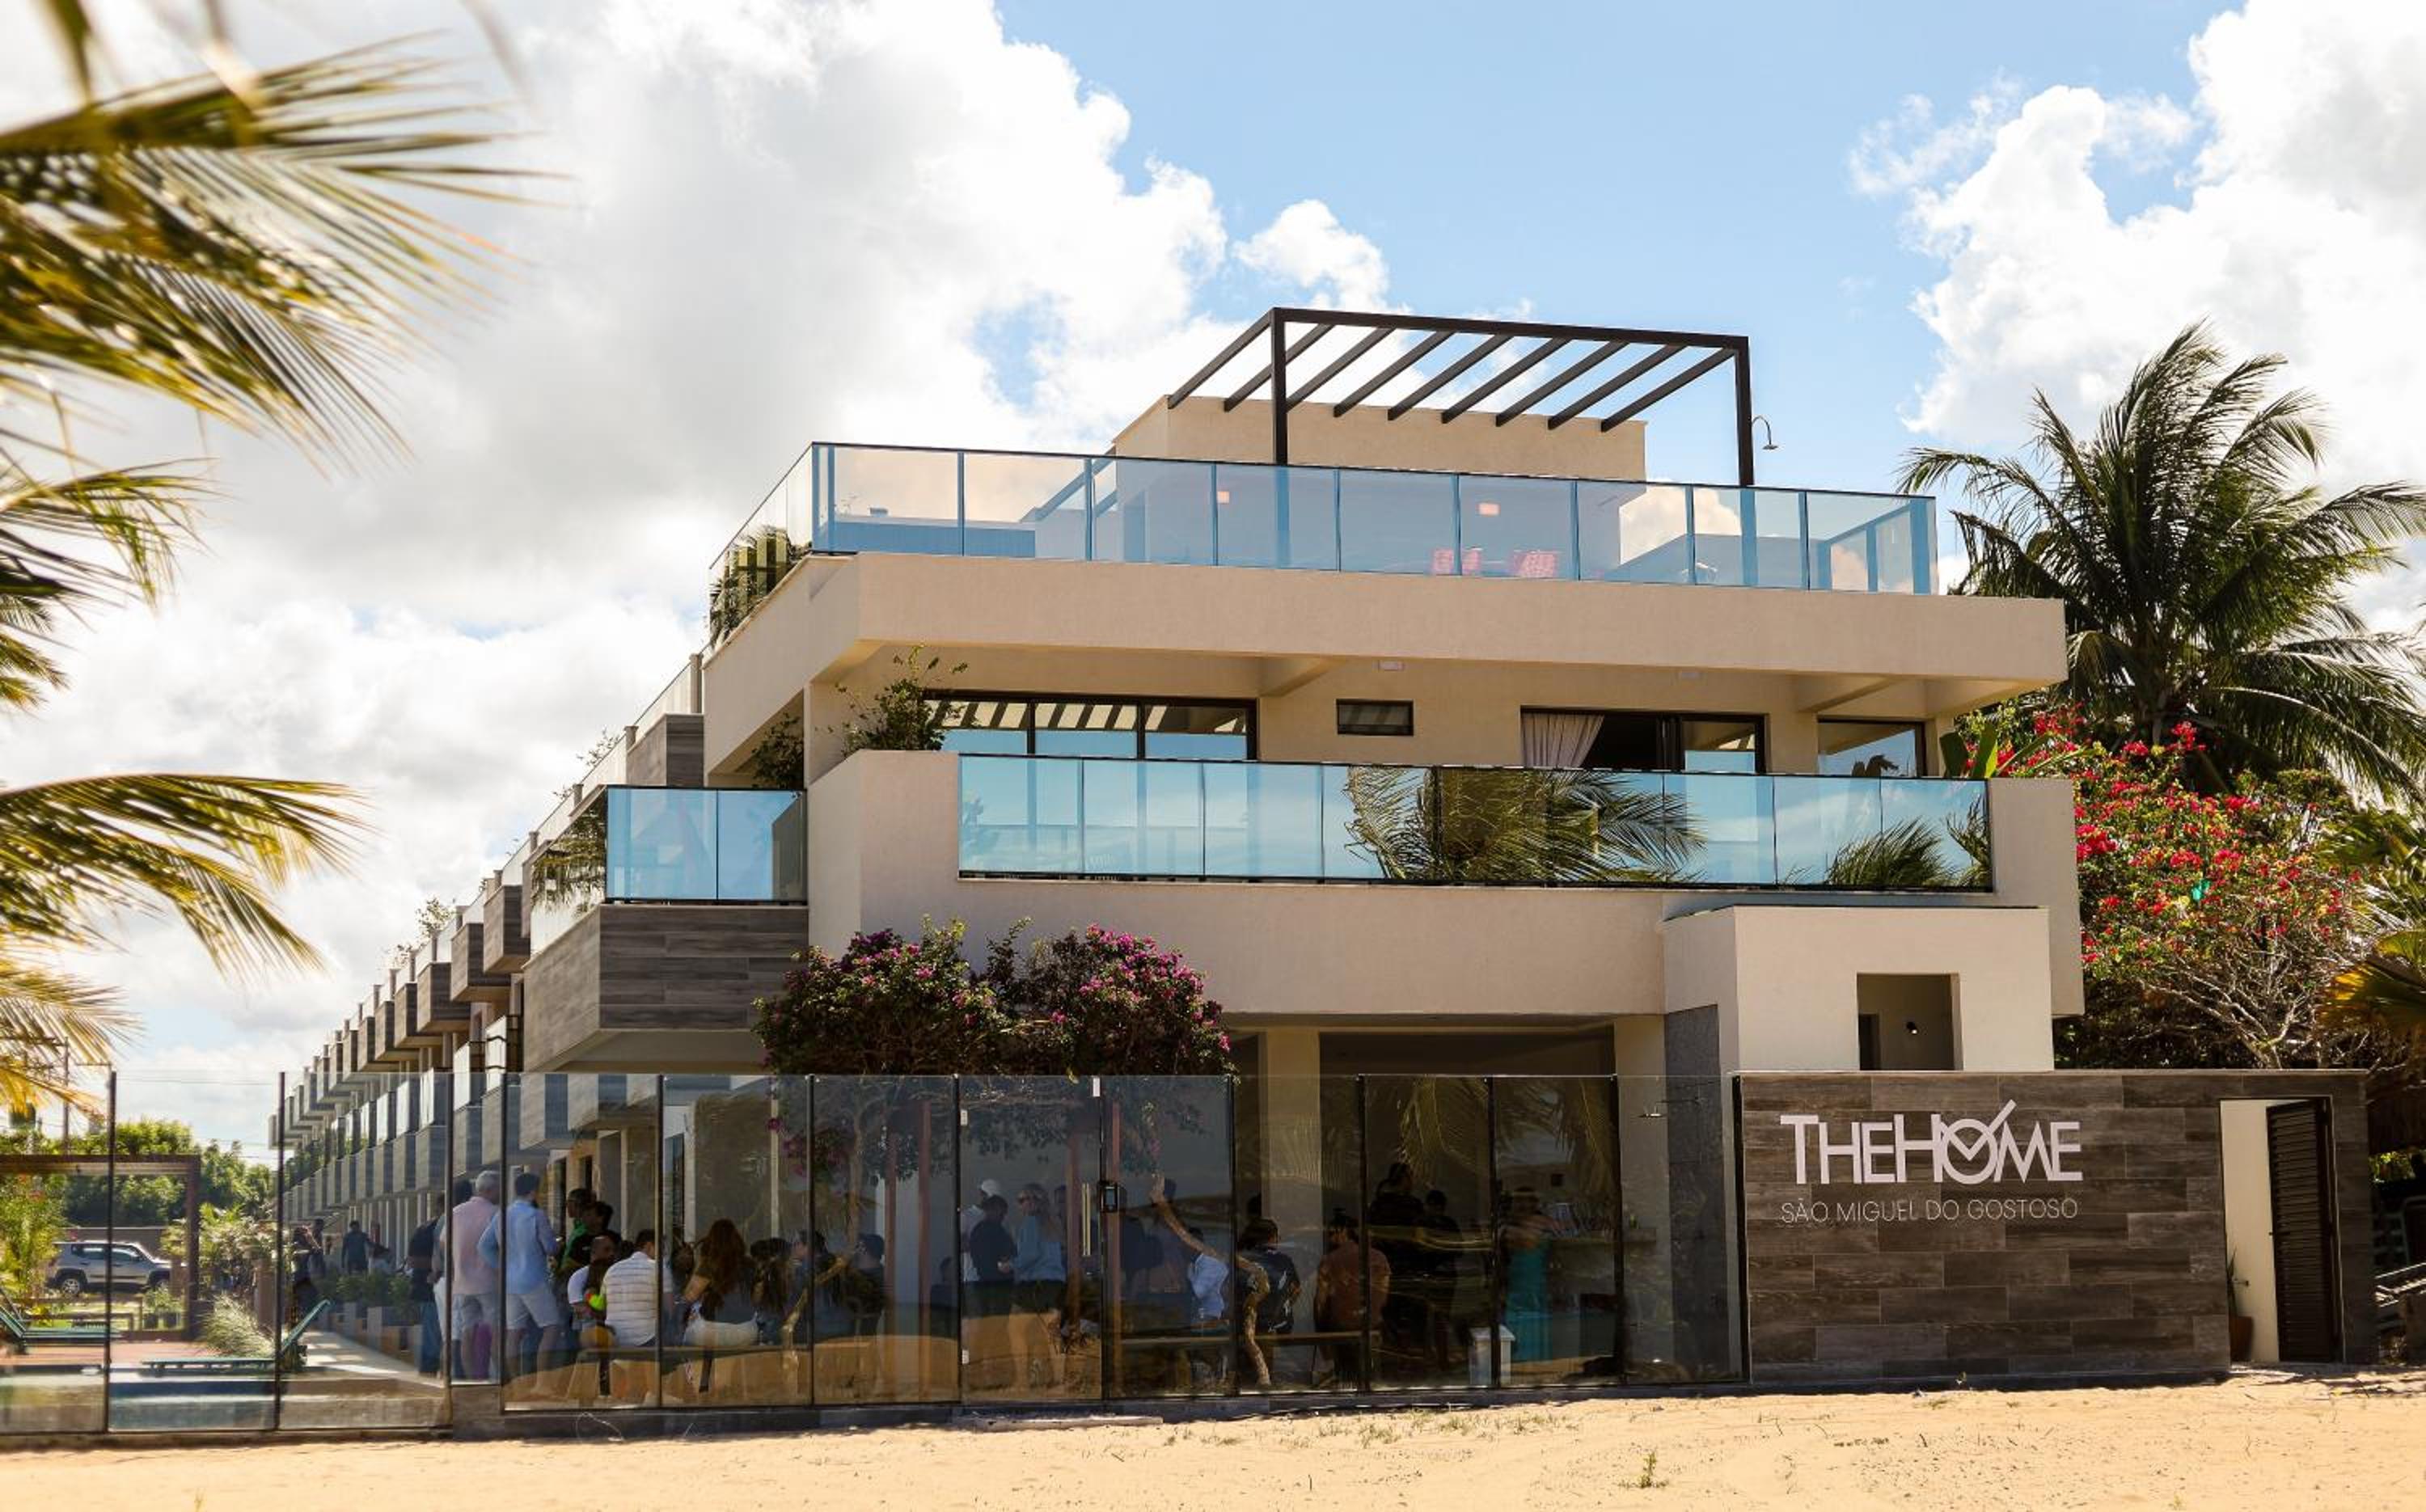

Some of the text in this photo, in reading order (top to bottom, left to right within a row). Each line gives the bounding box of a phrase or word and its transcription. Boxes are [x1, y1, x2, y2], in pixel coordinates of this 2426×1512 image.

[1781, 1197, 2077, 1223] SÃO MIGUEL DO GOSTOSO
